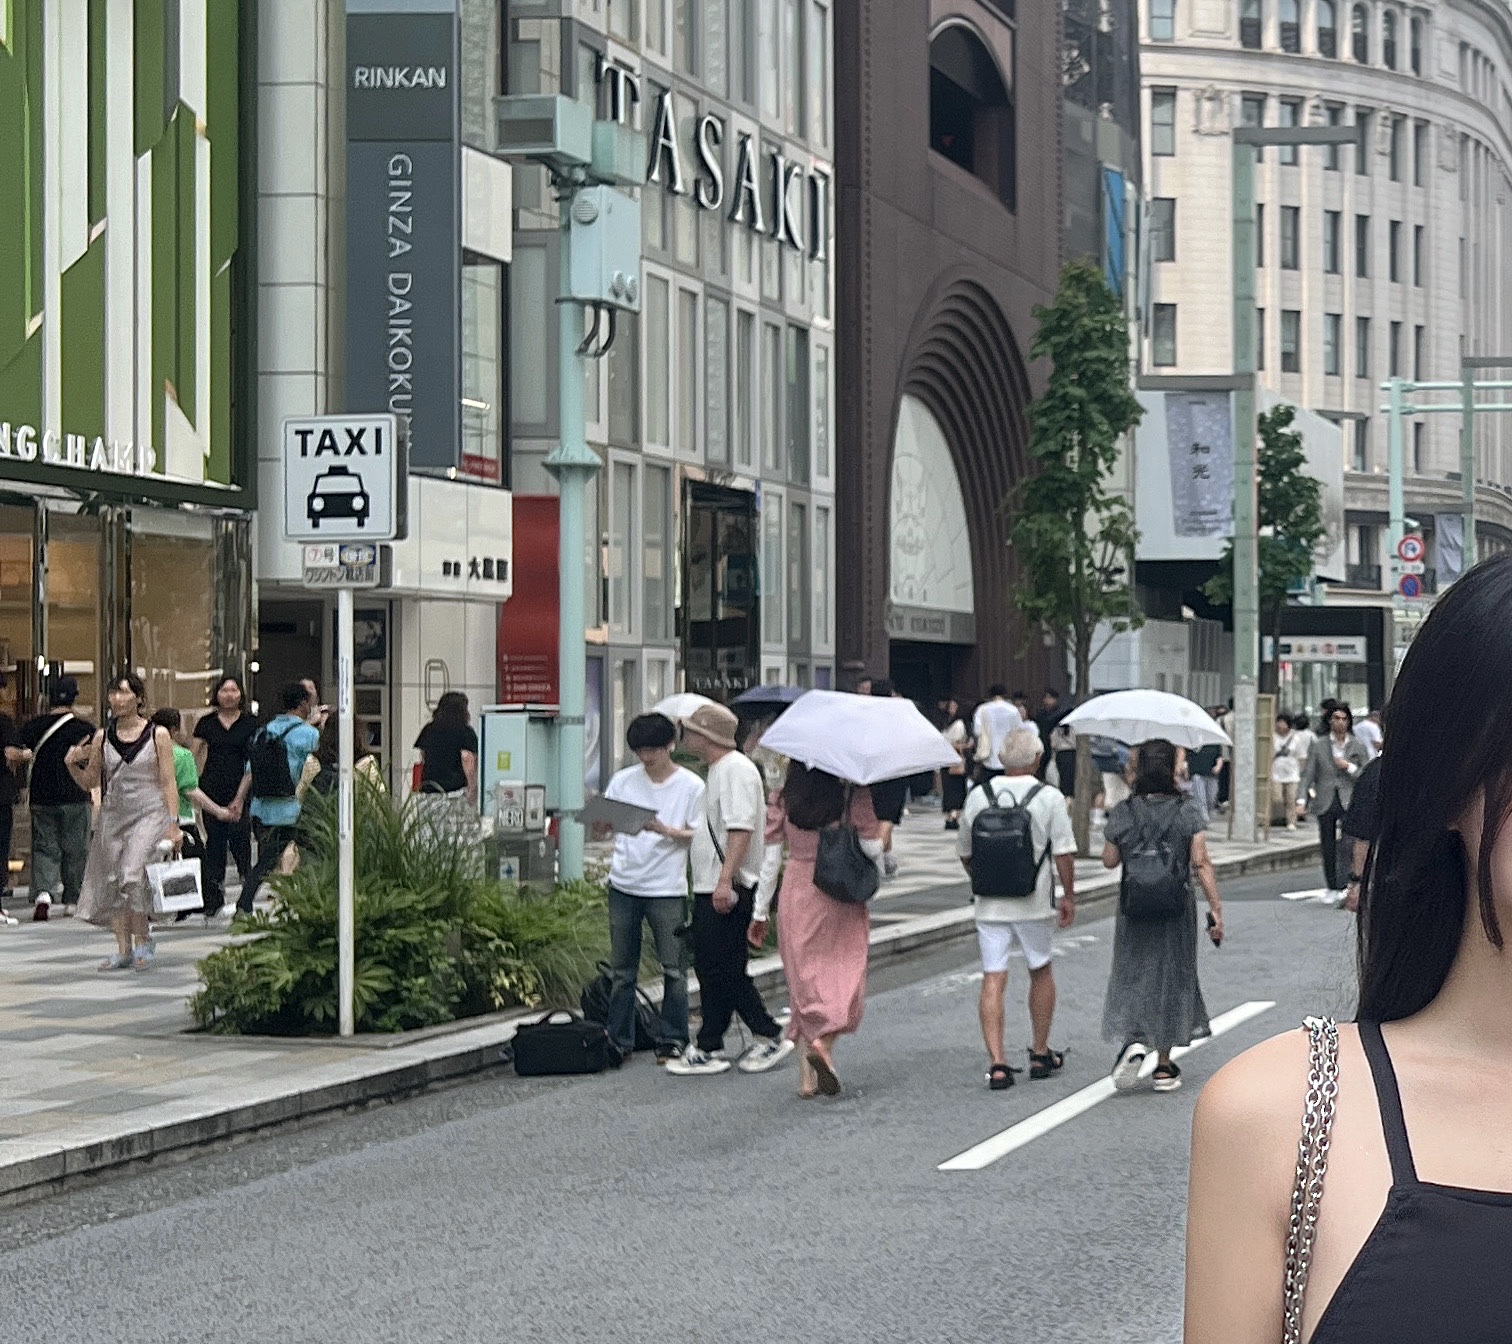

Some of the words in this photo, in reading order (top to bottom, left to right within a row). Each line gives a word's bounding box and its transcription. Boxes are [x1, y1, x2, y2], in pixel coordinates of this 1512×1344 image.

[353, 65, 447, 89] RINKAN
[387, 153, 413, 259] GINZA
[596, 55, 827, 263] TASAKI
[387, 272, 413, 448] DAIKOKU
[294, 426, 383, 458] TAXI
